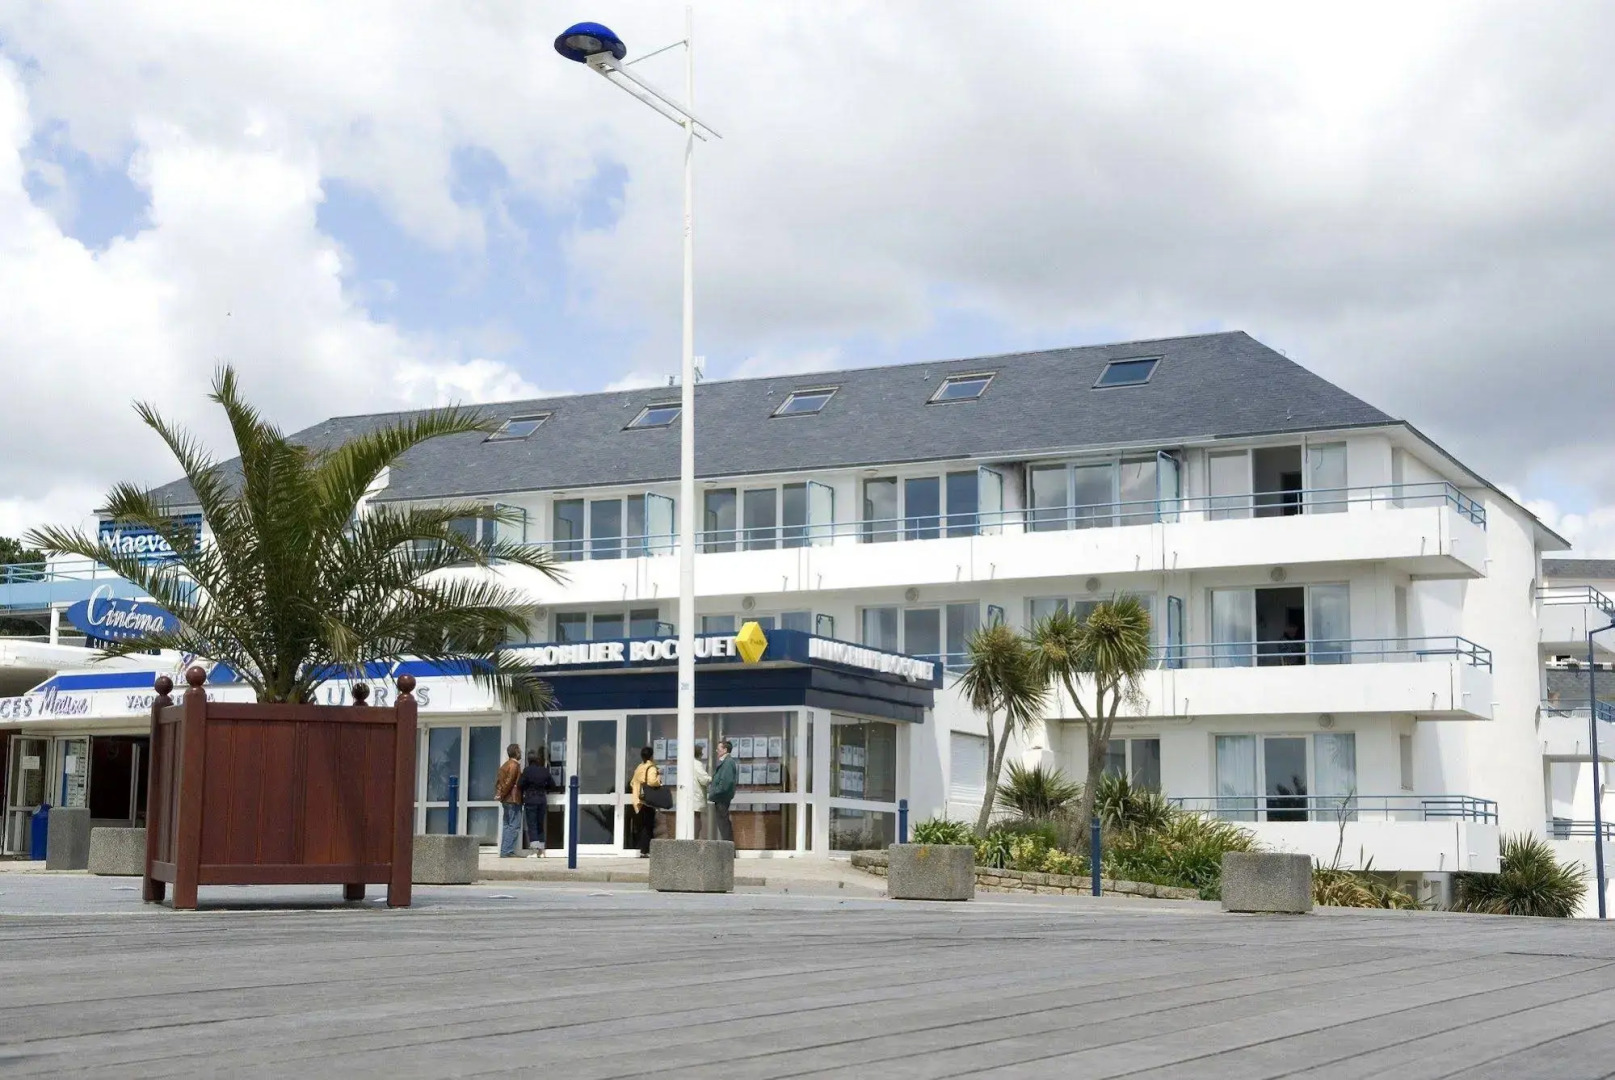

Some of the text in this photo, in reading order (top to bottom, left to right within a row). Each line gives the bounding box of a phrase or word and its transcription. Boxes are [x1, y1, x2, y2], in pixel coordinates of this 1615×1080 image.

[101, 530, 172, 554] Maeva
[87, 584, 165, 632] Cinéma
[629, 636, 737, 661] BOCUET
